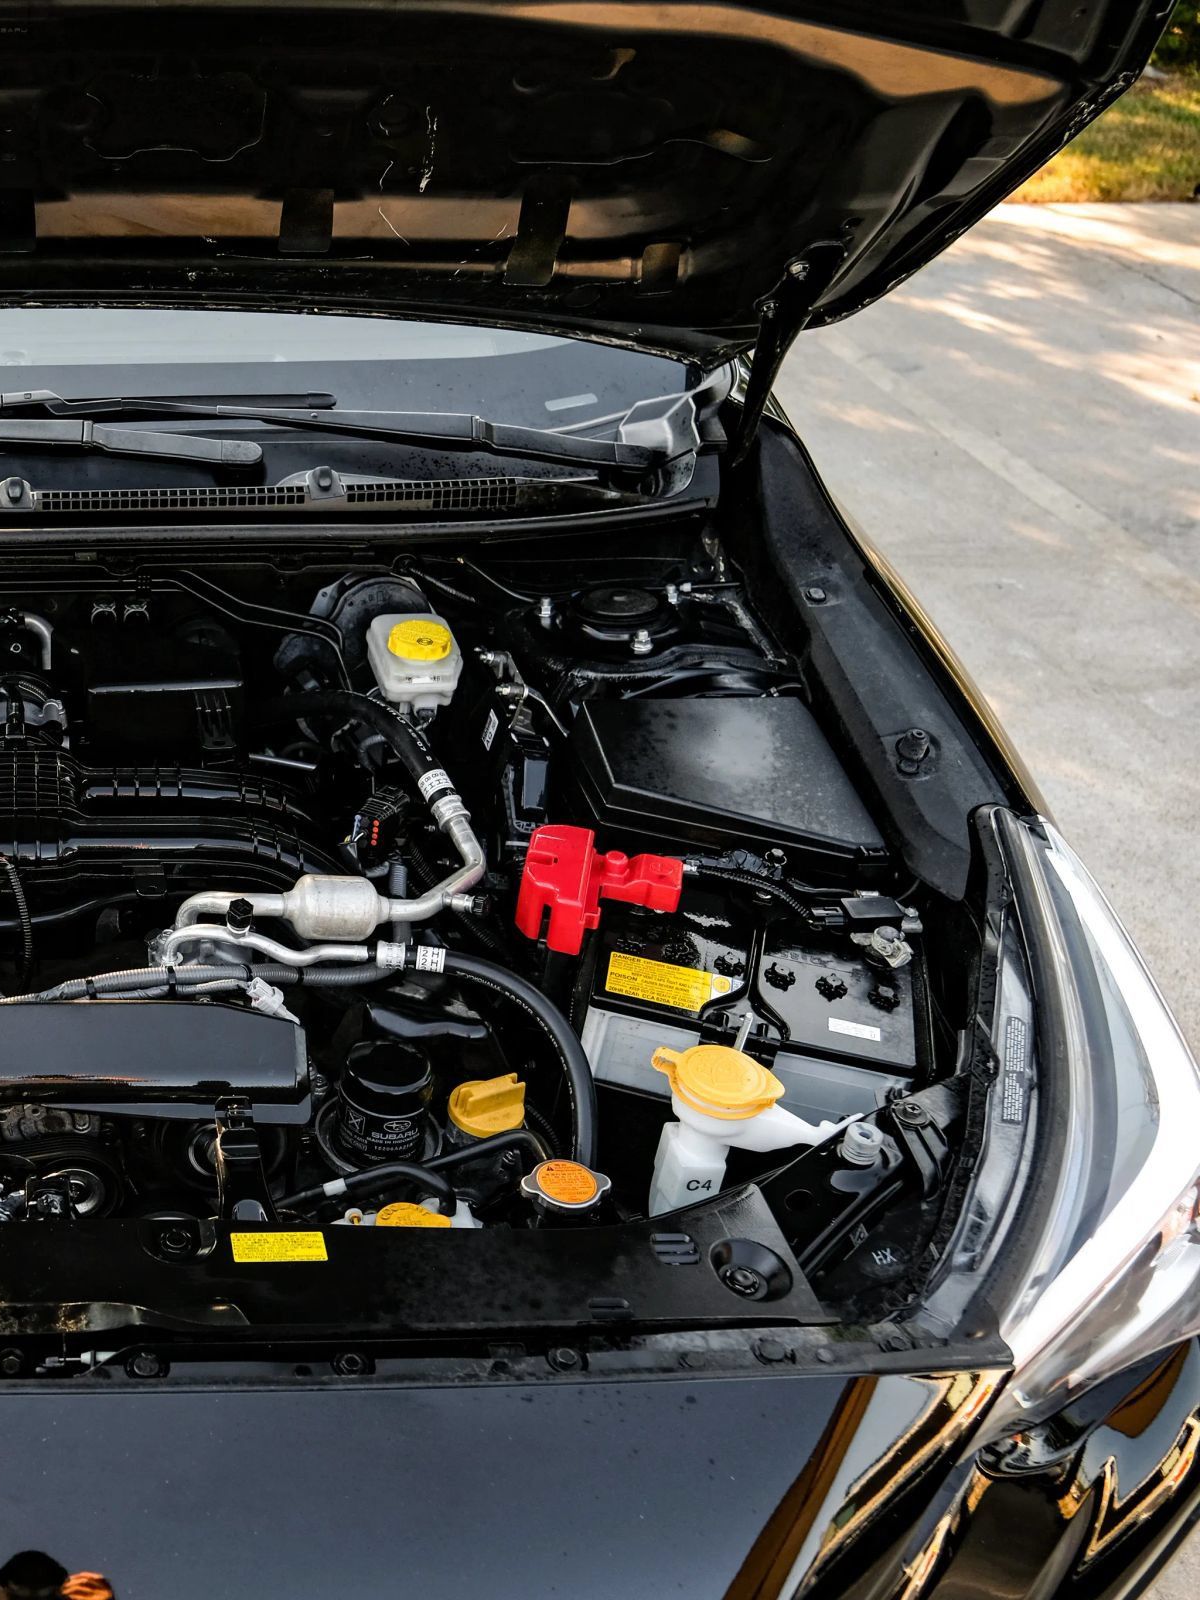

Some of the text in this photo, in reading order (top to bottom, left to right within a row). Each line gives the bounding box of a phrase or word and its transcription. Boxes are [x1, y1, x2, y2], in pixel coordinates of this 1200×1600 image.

[612, 953, 641, 963] DANGER
[610, 971, 638, 982] POISON
[371, 1128, 419, 1140] SUBARU
[686, 1179, 712, 1191] C4
[871, 1247, 898, 1265] HX
